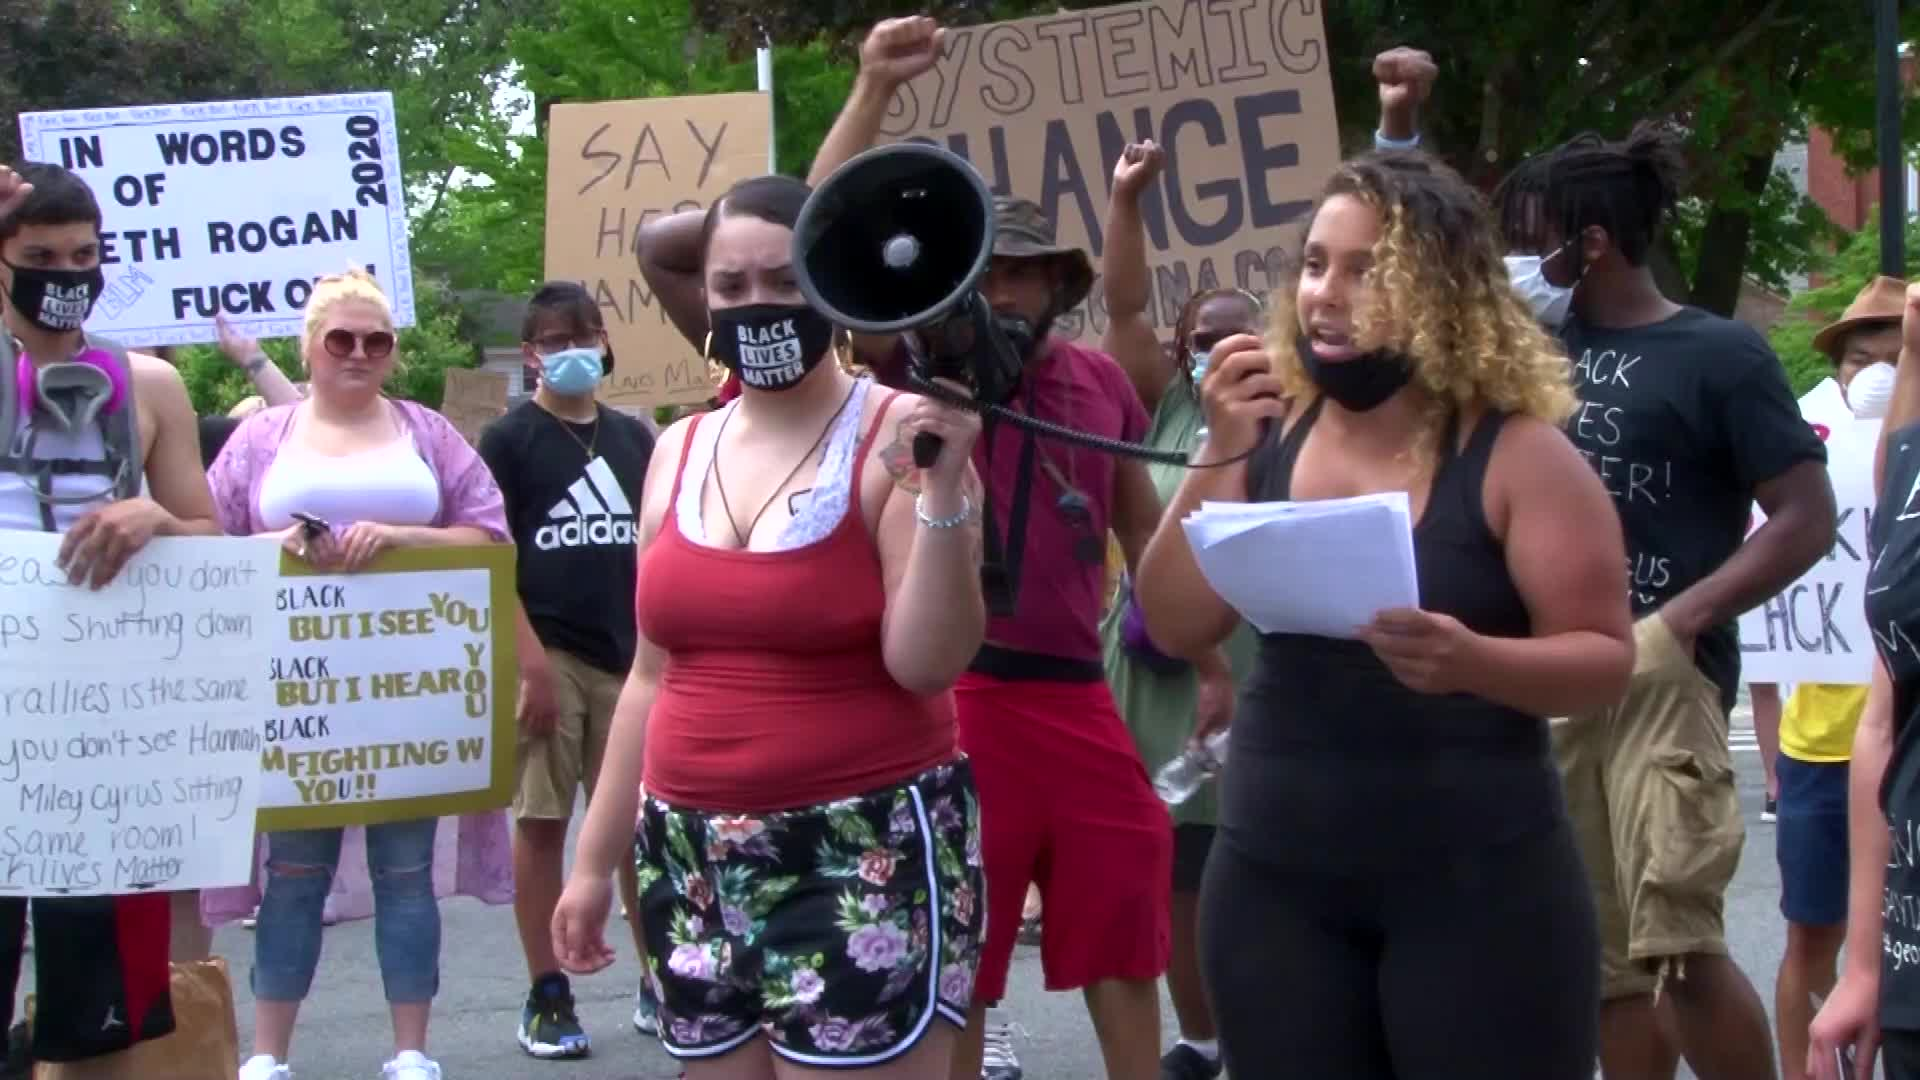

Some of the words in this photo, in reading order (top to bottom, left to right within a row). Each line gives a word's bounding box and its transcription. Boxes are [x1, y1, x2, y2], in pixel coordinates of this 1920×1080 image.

[60, 136, 103, 169] IN
[157, 126, 306, 166] WORDS
[345, 114, 389, 208] 2020
[578, 119, 728, 195] SAY
[113, 173, 167, 207] OF
[905, 87, 1315, 259] HANGE
[208, 208, 358, 254] ROGAN
[172, 279, 276, 320] FUCK
[737, 318, 796, 344] BLACK
[741, 342, 798, 366] LIVES
[742, 361, 804, 386] MATTER
[1582, 450, 1671, 504] ER!
[275, 585, 345, 611] BLACK
[289, 615, 353, 641] BUT
[358, 613, 376, 638] I
[379, 609, 435, 635] SEE
[430, 593, 489, 632] YOU
[276, 679, 340, 707] BUT
[346, 677, 362, 703] I
[371, 668, 462, 699] HEAR
[464, 643, 487, 718] YOU
[264, 715, 330, 742] BLACK
[0, 738, 58, 782] you
[138, 729, 177, 755] see
[287, 741, 449, 778] FIGHTING
[456, 737, 485, 763] W
[20, 784, 83, 824] Miley
